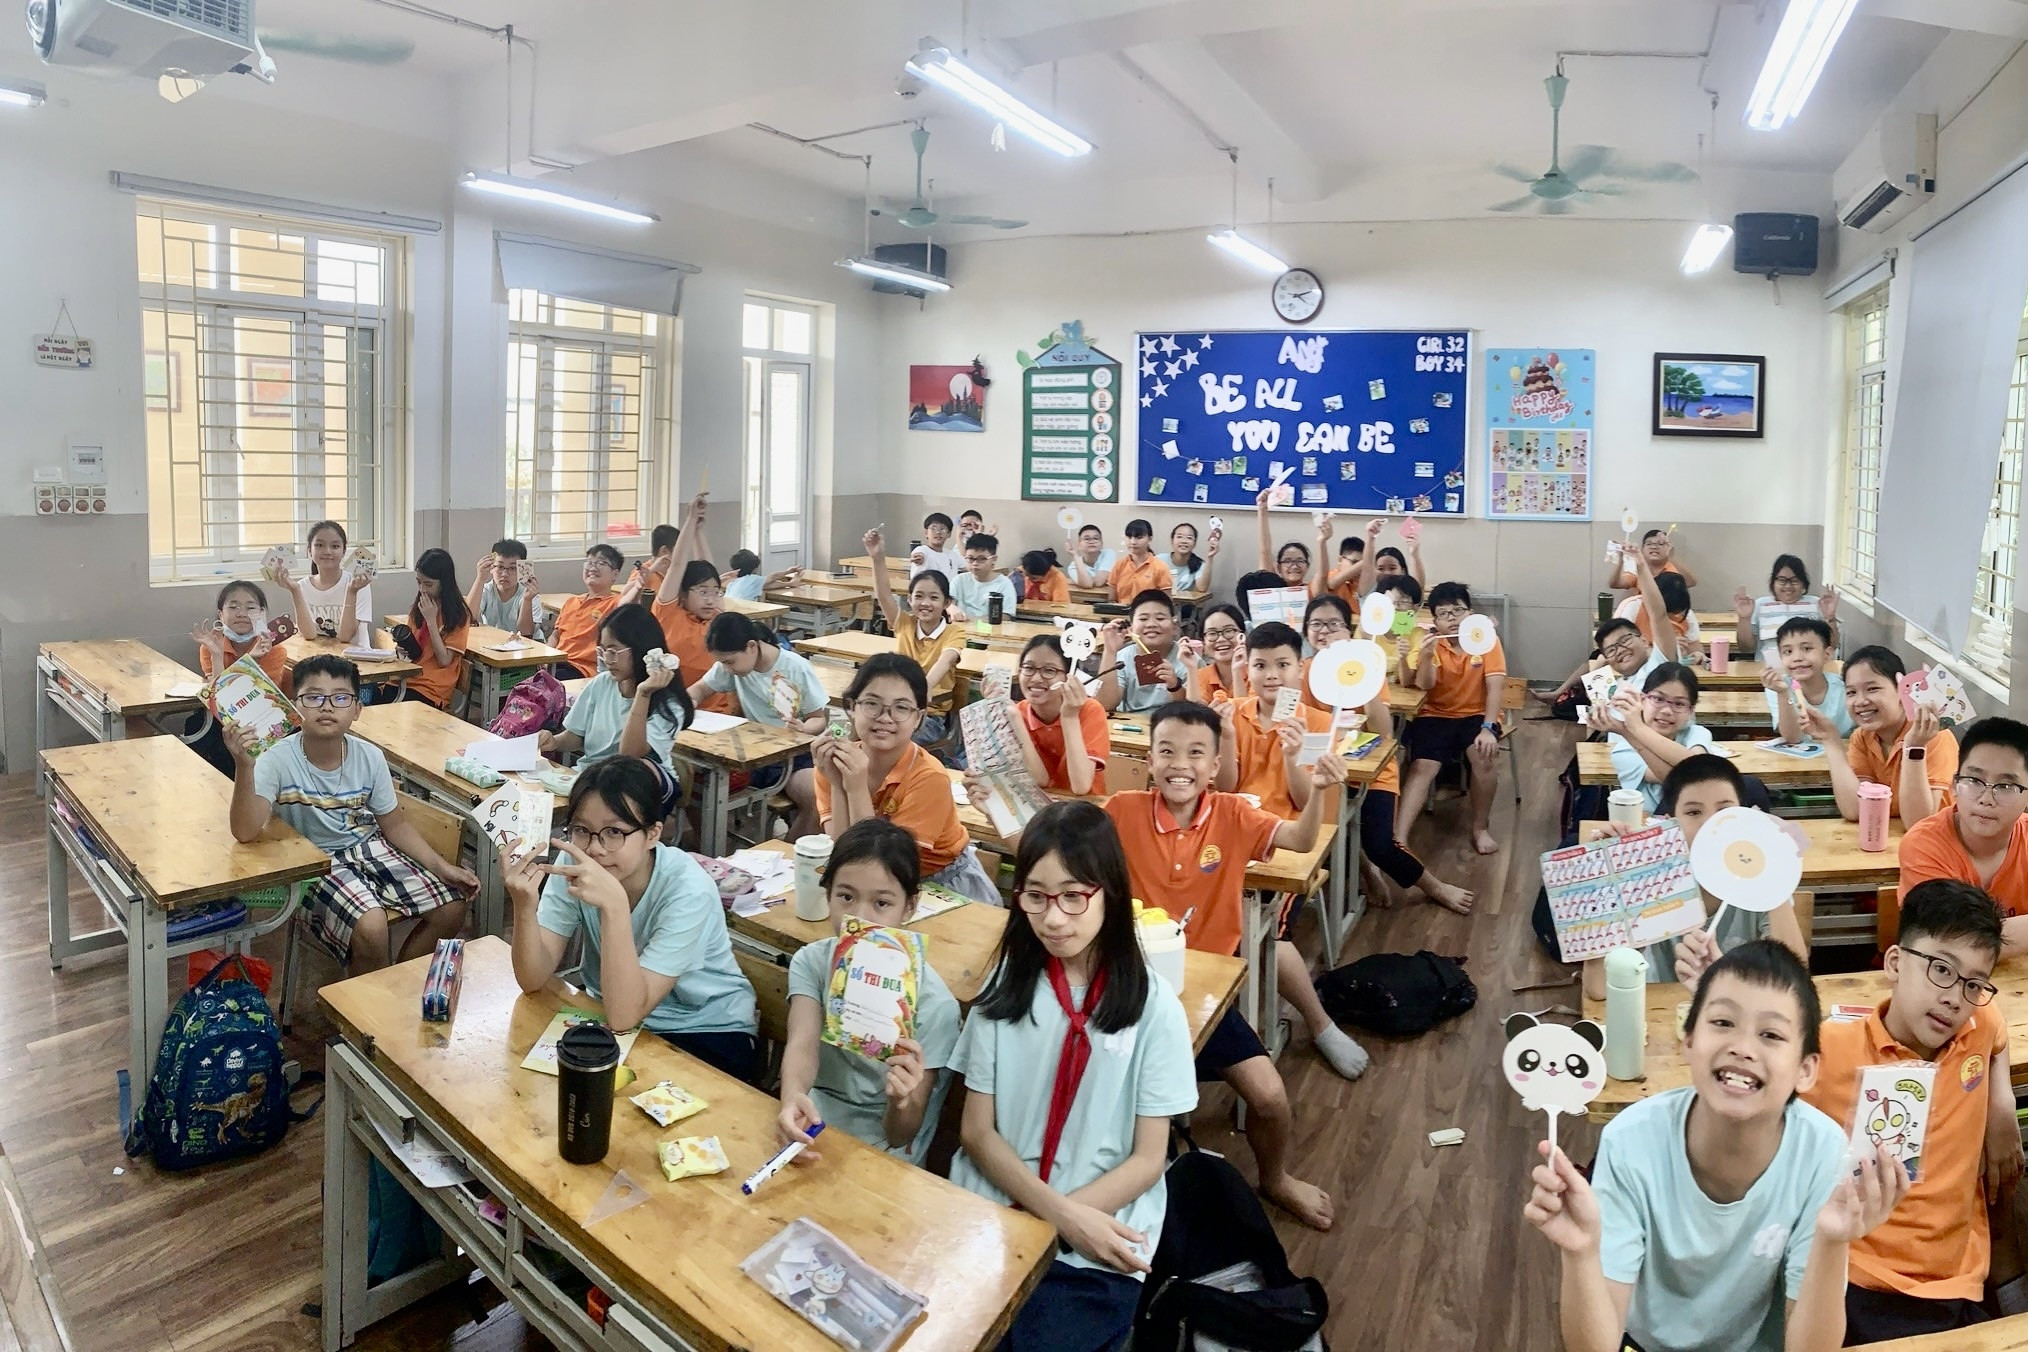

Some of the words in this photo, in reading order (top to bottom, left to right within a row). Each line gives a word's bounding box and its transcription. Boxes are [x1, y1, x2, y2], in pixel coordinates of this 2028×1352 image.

[1416, 336, 1445, 353] GIRL
[1446, 336, 1465, 353] 32
[1415, 355, 1445, 372] BOY
[1444, 356, 1466, 373] 34
[1199, 373, 1247, 415] BE
[1254, 378, 1302, 411] ALL
[1522, 400, 1572, 418] Birthday
[1227, 420, 1281, 452] YOU
[1295, 421, 1351, 453] CAN
[1357, 421, 1395, 453] BE
[864, 972, 881, 987] THI
